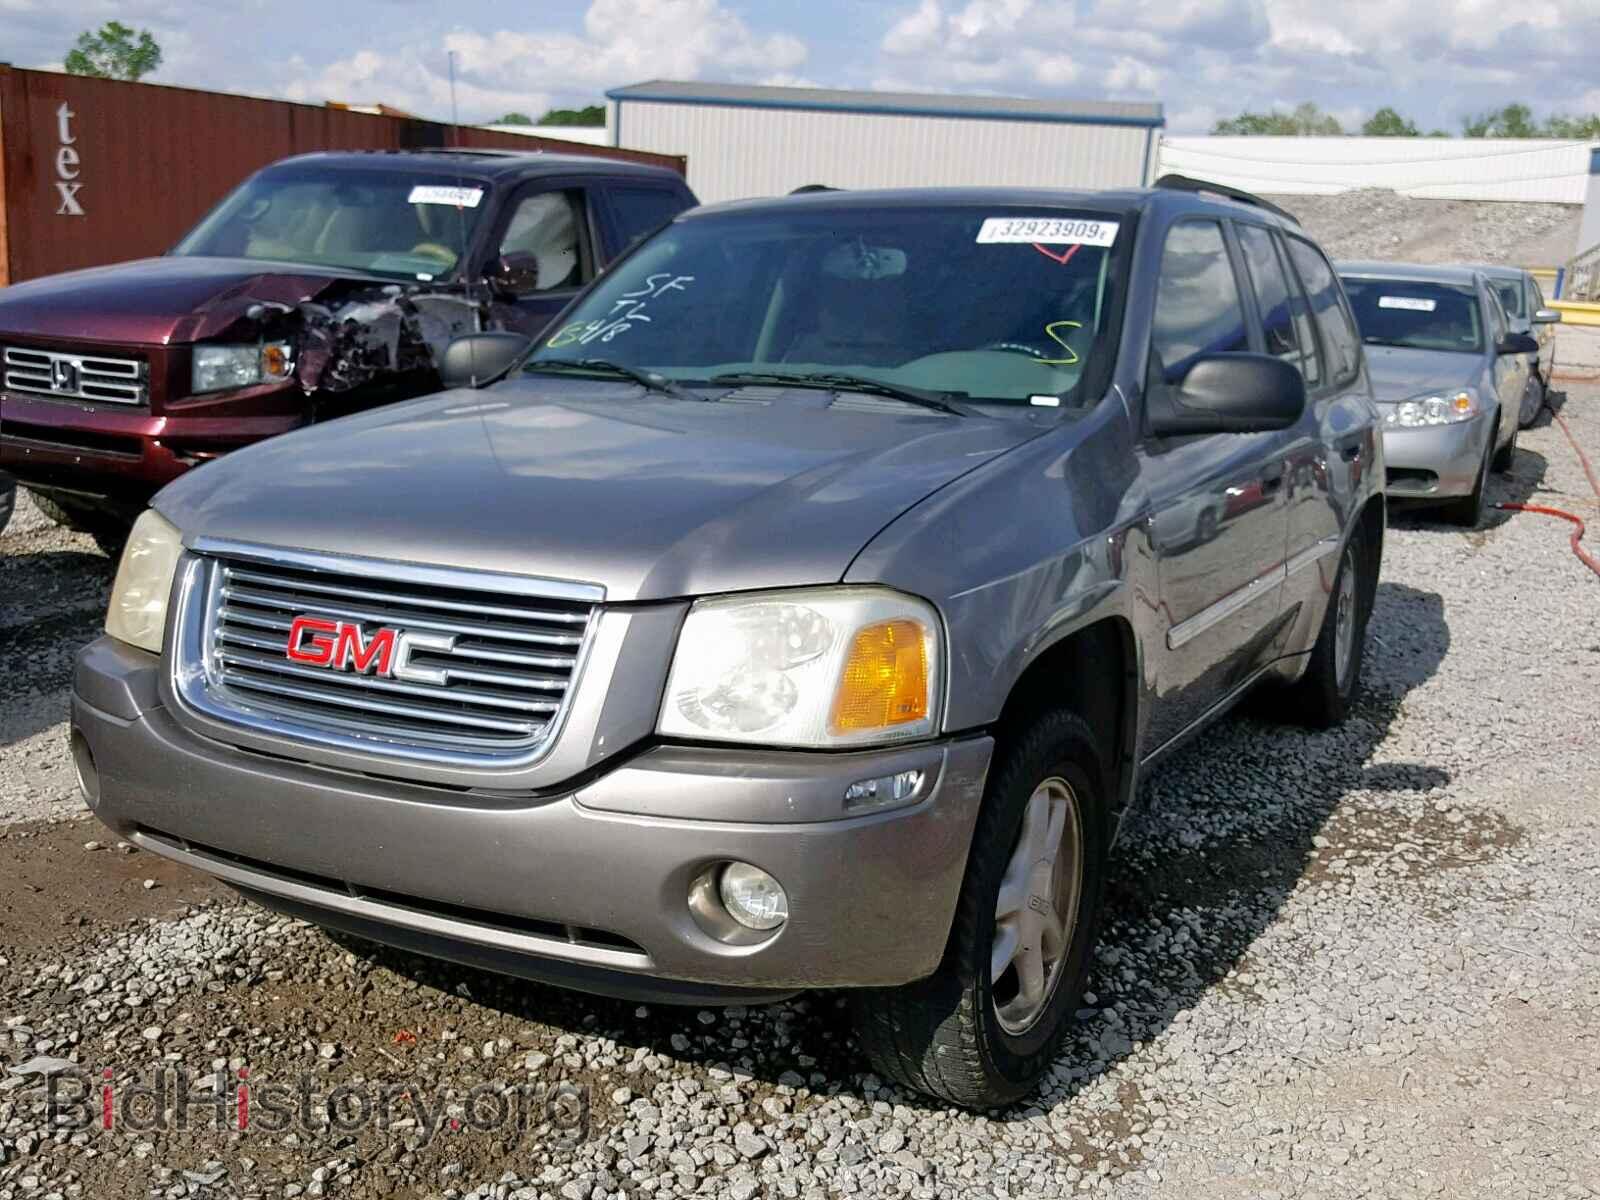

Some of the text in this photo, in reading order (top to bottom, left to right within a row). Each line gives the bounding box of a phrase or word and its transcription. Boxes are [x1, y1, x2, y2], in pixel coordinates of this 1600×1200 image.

[55, 100, 85, 215] tex
[623, 273, 695, 298] SF
[287, 614, 457, 687] GMC
